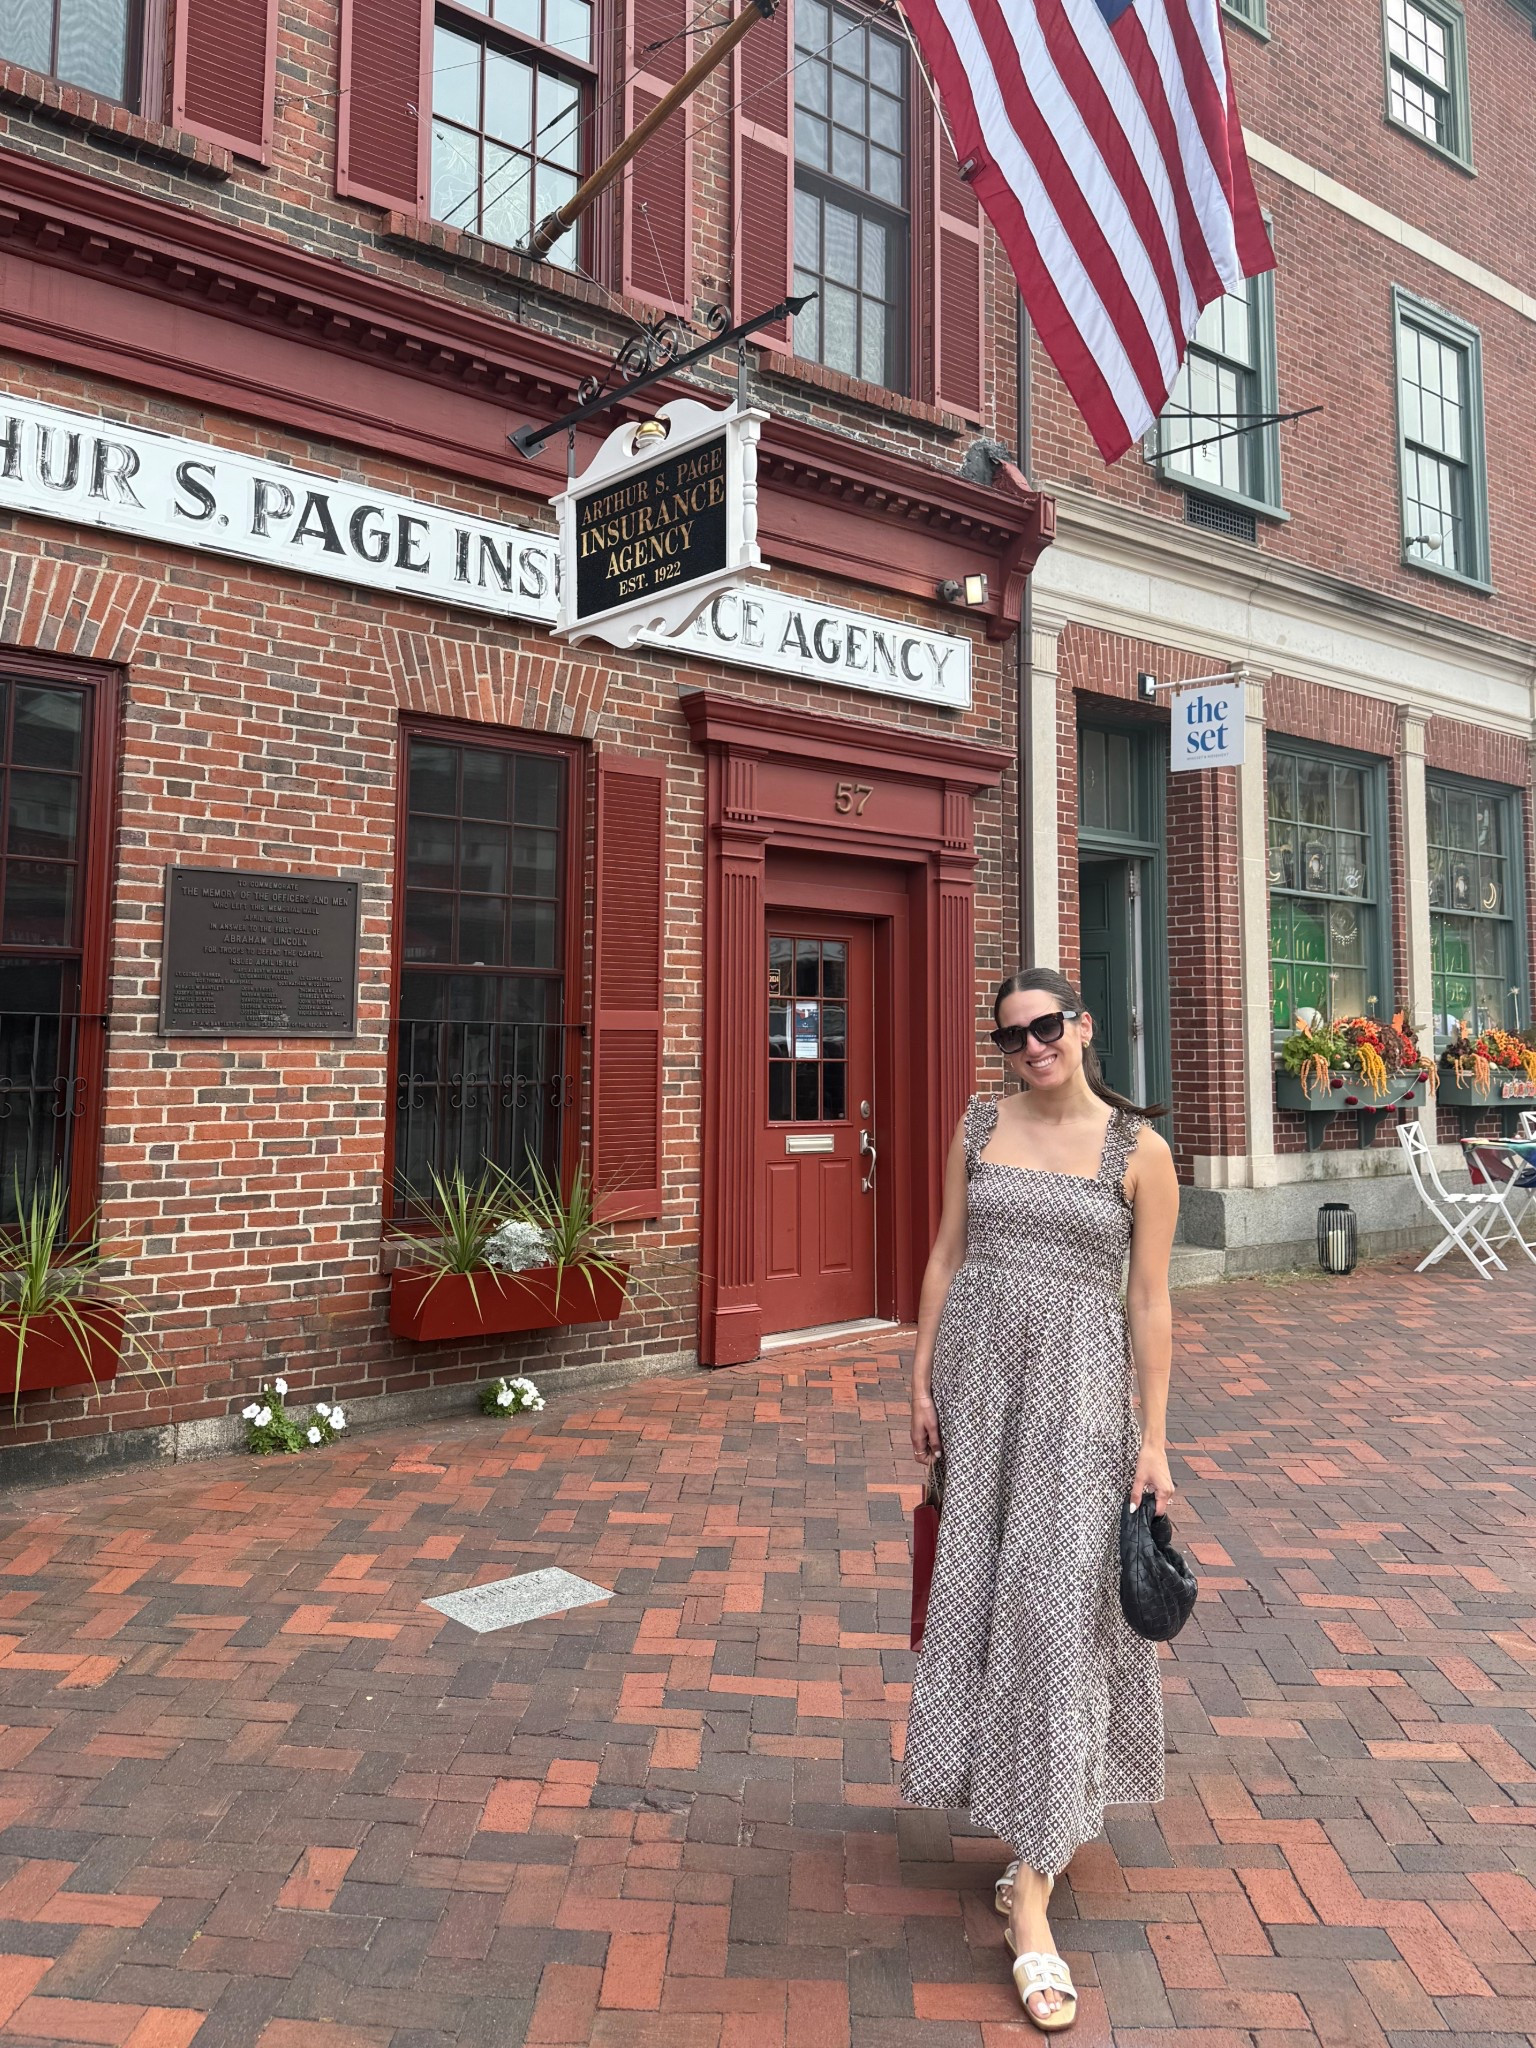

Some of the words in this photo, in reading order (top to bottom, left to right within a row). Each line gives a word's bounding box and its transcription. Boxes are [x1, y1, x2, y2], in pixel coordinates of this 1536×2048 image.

[581, 480, 649, 527] ARTHUR
[655, 473, 670, 495] S.
[677, 447, 724, 486] PAGE
[580, 474, 725, 559] INSURANCE
[606, 520, 694, 579] AGENCY
[174, 460, 230, 528] S.
[252, 476, 431, 573] PAGE
[778, 610, 954, 689] AGENCY
[619, 574, 649, 597] EST.
[654, 561, 681, 585] 1922
[1186, 696, 1228, 725] the
[1187, 723, 1229, 754] set
[835, 782, 874, 816] 57
[182, 886, 199, 896] THE
[202, 888, 238, 898] MEMORY
[240, 891, 251, 899] OF
[254, 892, 269, 901] THE
[272, 893, 309, 903] OFFICERS
[314, 896, 329, 905] AND
[332, 897, 348, 906] MEN
[250, 881, 299, 891] COMMEMORATE
[213, 901, 228, 909] WHO
[231, 902, 248, 910] LEFT
[220, 923, 247, 931] ANSWER
[224, 934, 267, 945] ABRAHAM
[273, 937, 308, 946] LINCOLN
